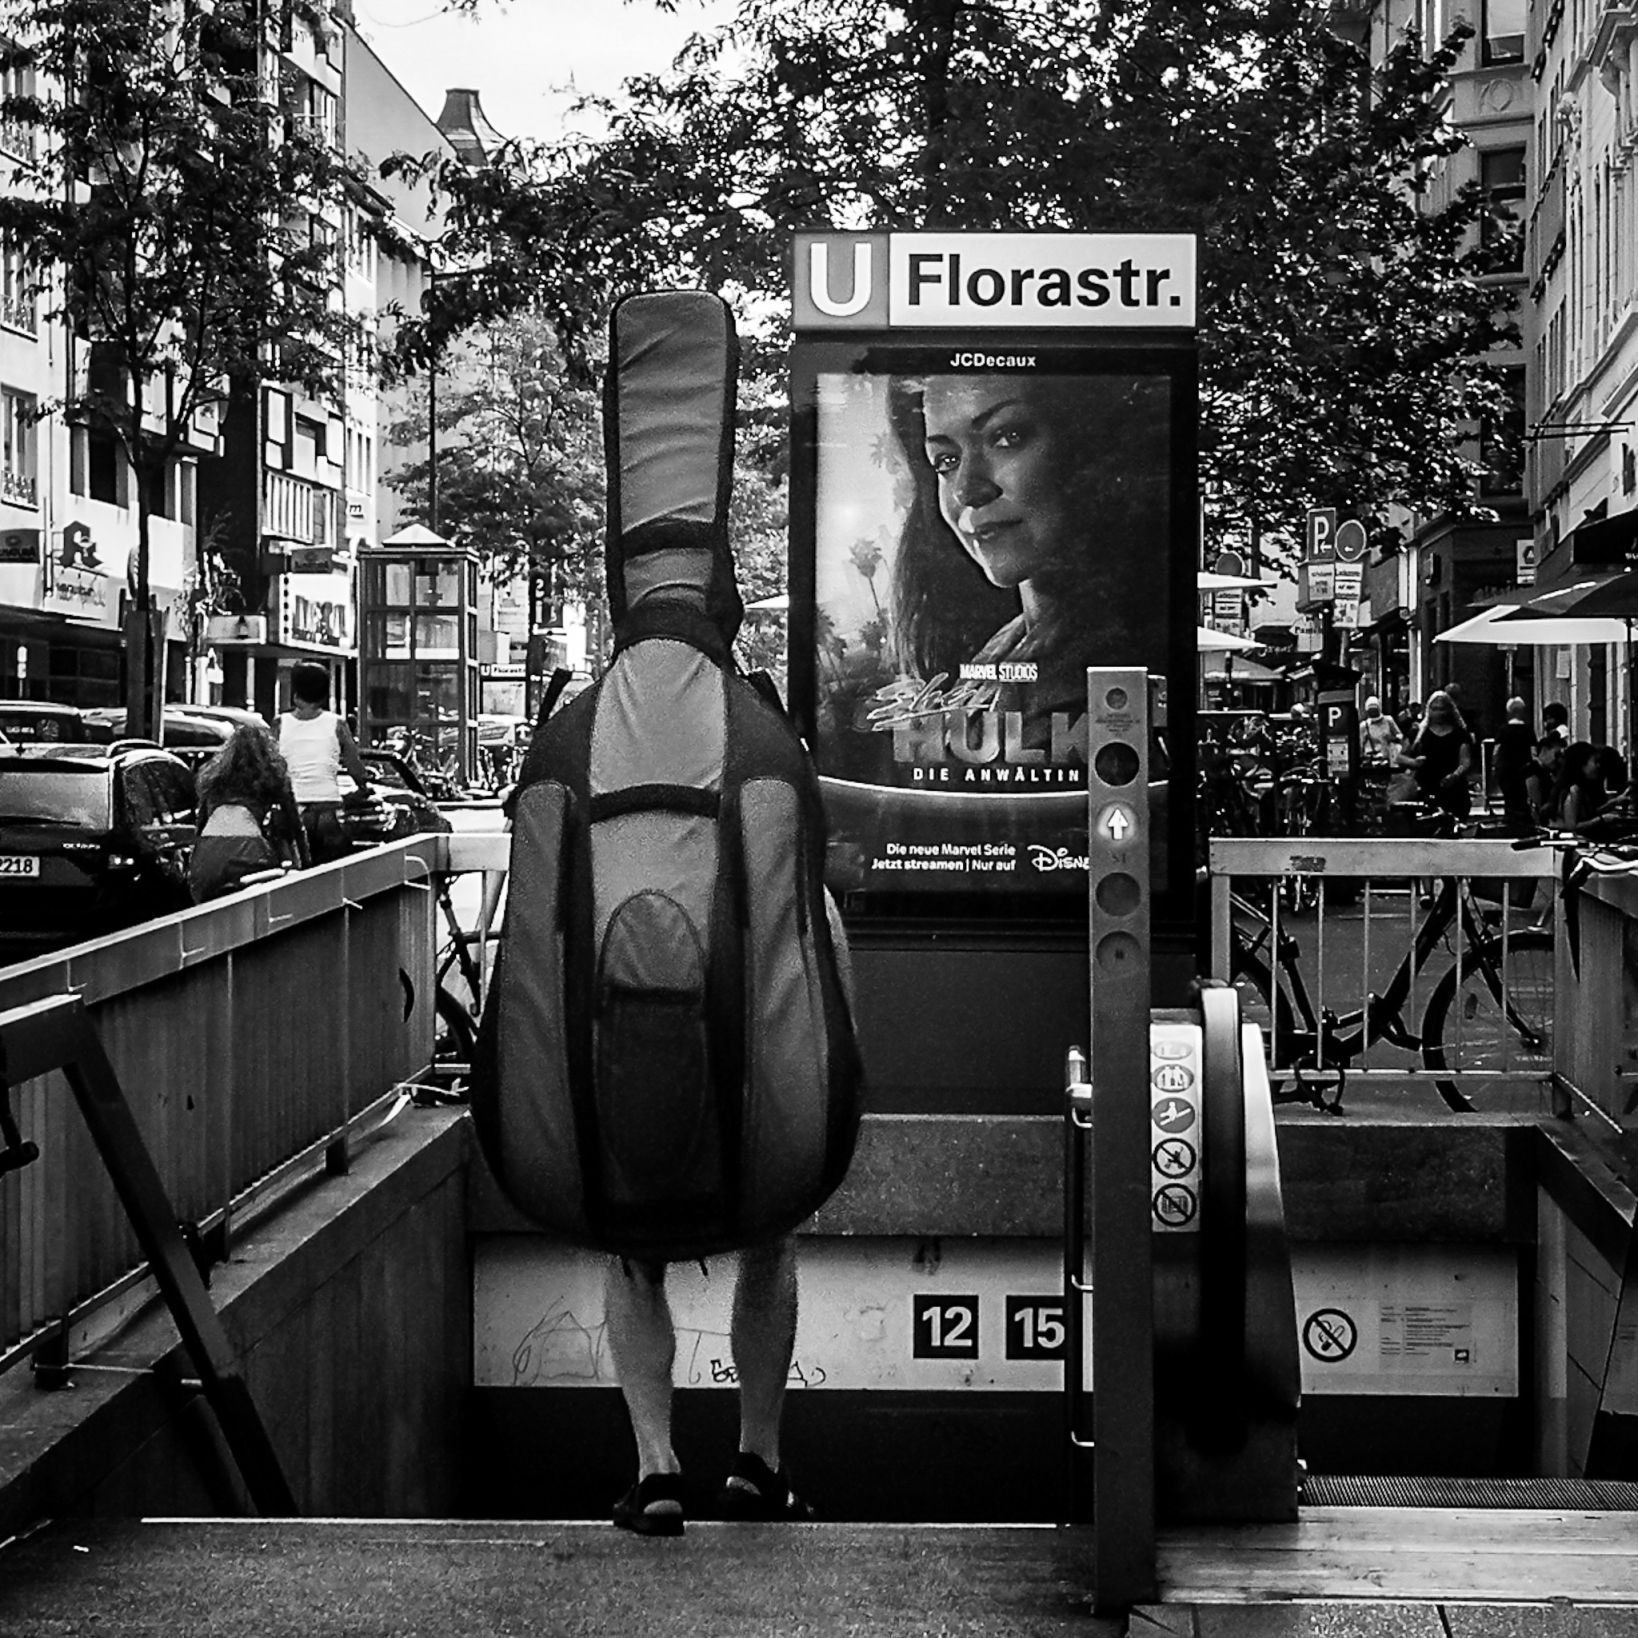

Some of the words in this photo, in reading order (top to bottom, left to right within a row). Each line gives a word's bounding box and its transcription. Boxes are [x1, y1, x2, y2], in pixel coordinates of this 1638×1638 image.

[810, 242, 872, 317] U
[908, 252, 1182, 307] Florastr.
[950, 353, 1037, 368] JCDecaux
[1313, 515, 1330, 555] P
[960, 664, 998, 680] MARVEL
[998, 662, 1038, 682] STUDIOS
[1328, 706, 1342, 728] P
[913, 767, 949, 780] DIE
[965, 766, 1079, 782] ANWÄLTIN
[886, 844, 907, 855] Die
[909, 846, 938, 856] neue
[941, 844, 982, 856] Marvel
[984, 844, 1016, 855] Serie
[871, 859, 902, 870] Jetzt
[904, 860, 963, 871] streamen
[972, 860, 994, 871] Nur
[996, 859, 1016, 871] auf
[922, 1306, 973, 1347] 12
[1014, 1307, 1065, 1349] 15
